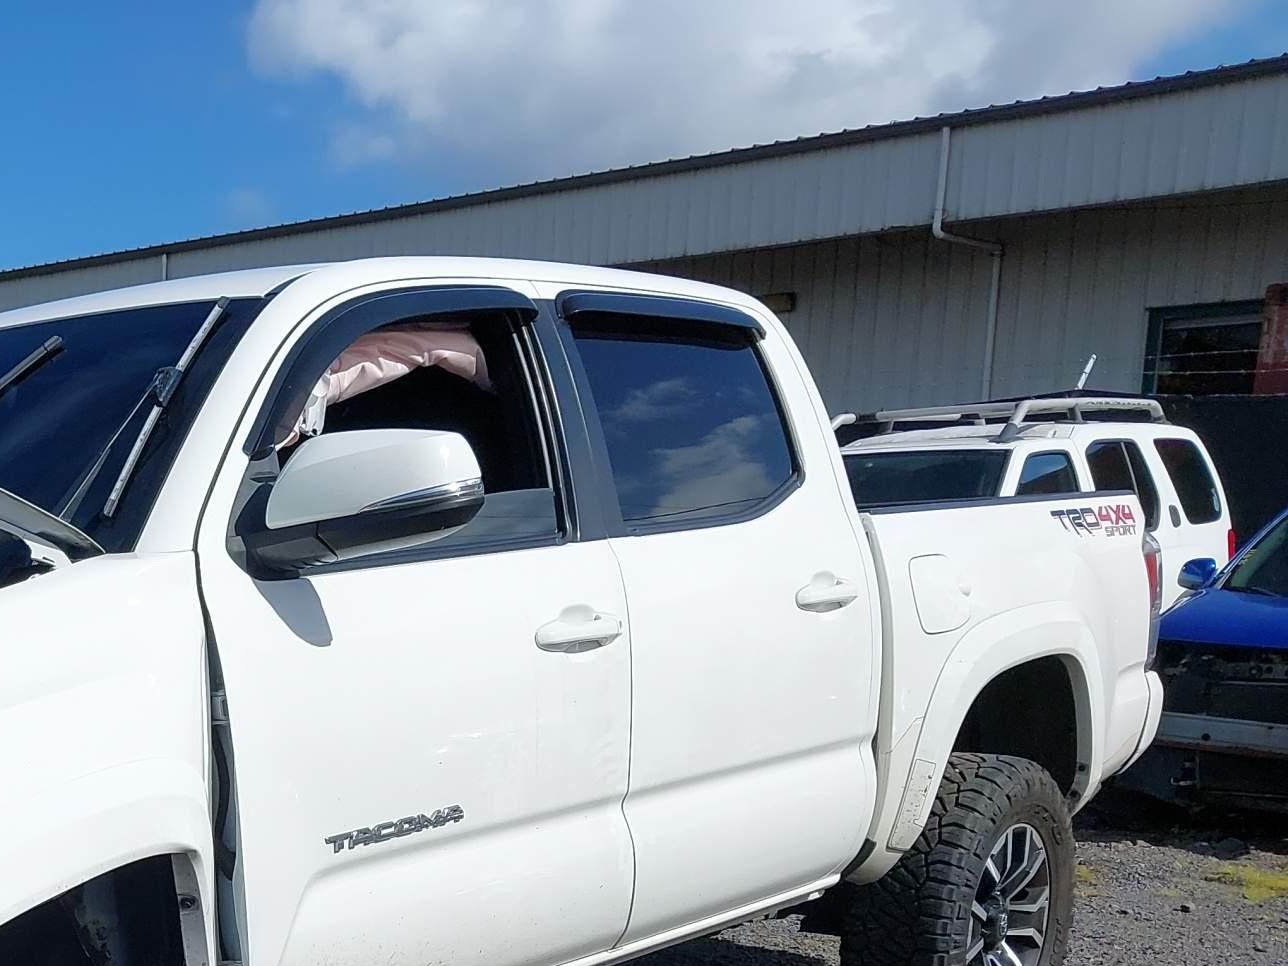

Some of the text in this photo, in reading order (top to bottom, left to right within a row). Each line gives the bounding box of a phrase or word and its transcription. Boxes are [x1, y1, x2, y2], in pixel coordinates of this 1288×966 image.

[1050, 507, 1102, 538] TRD
[1104, 524, 1137, 537] SPORT
[324, 804, 465, 854] TACOMA
